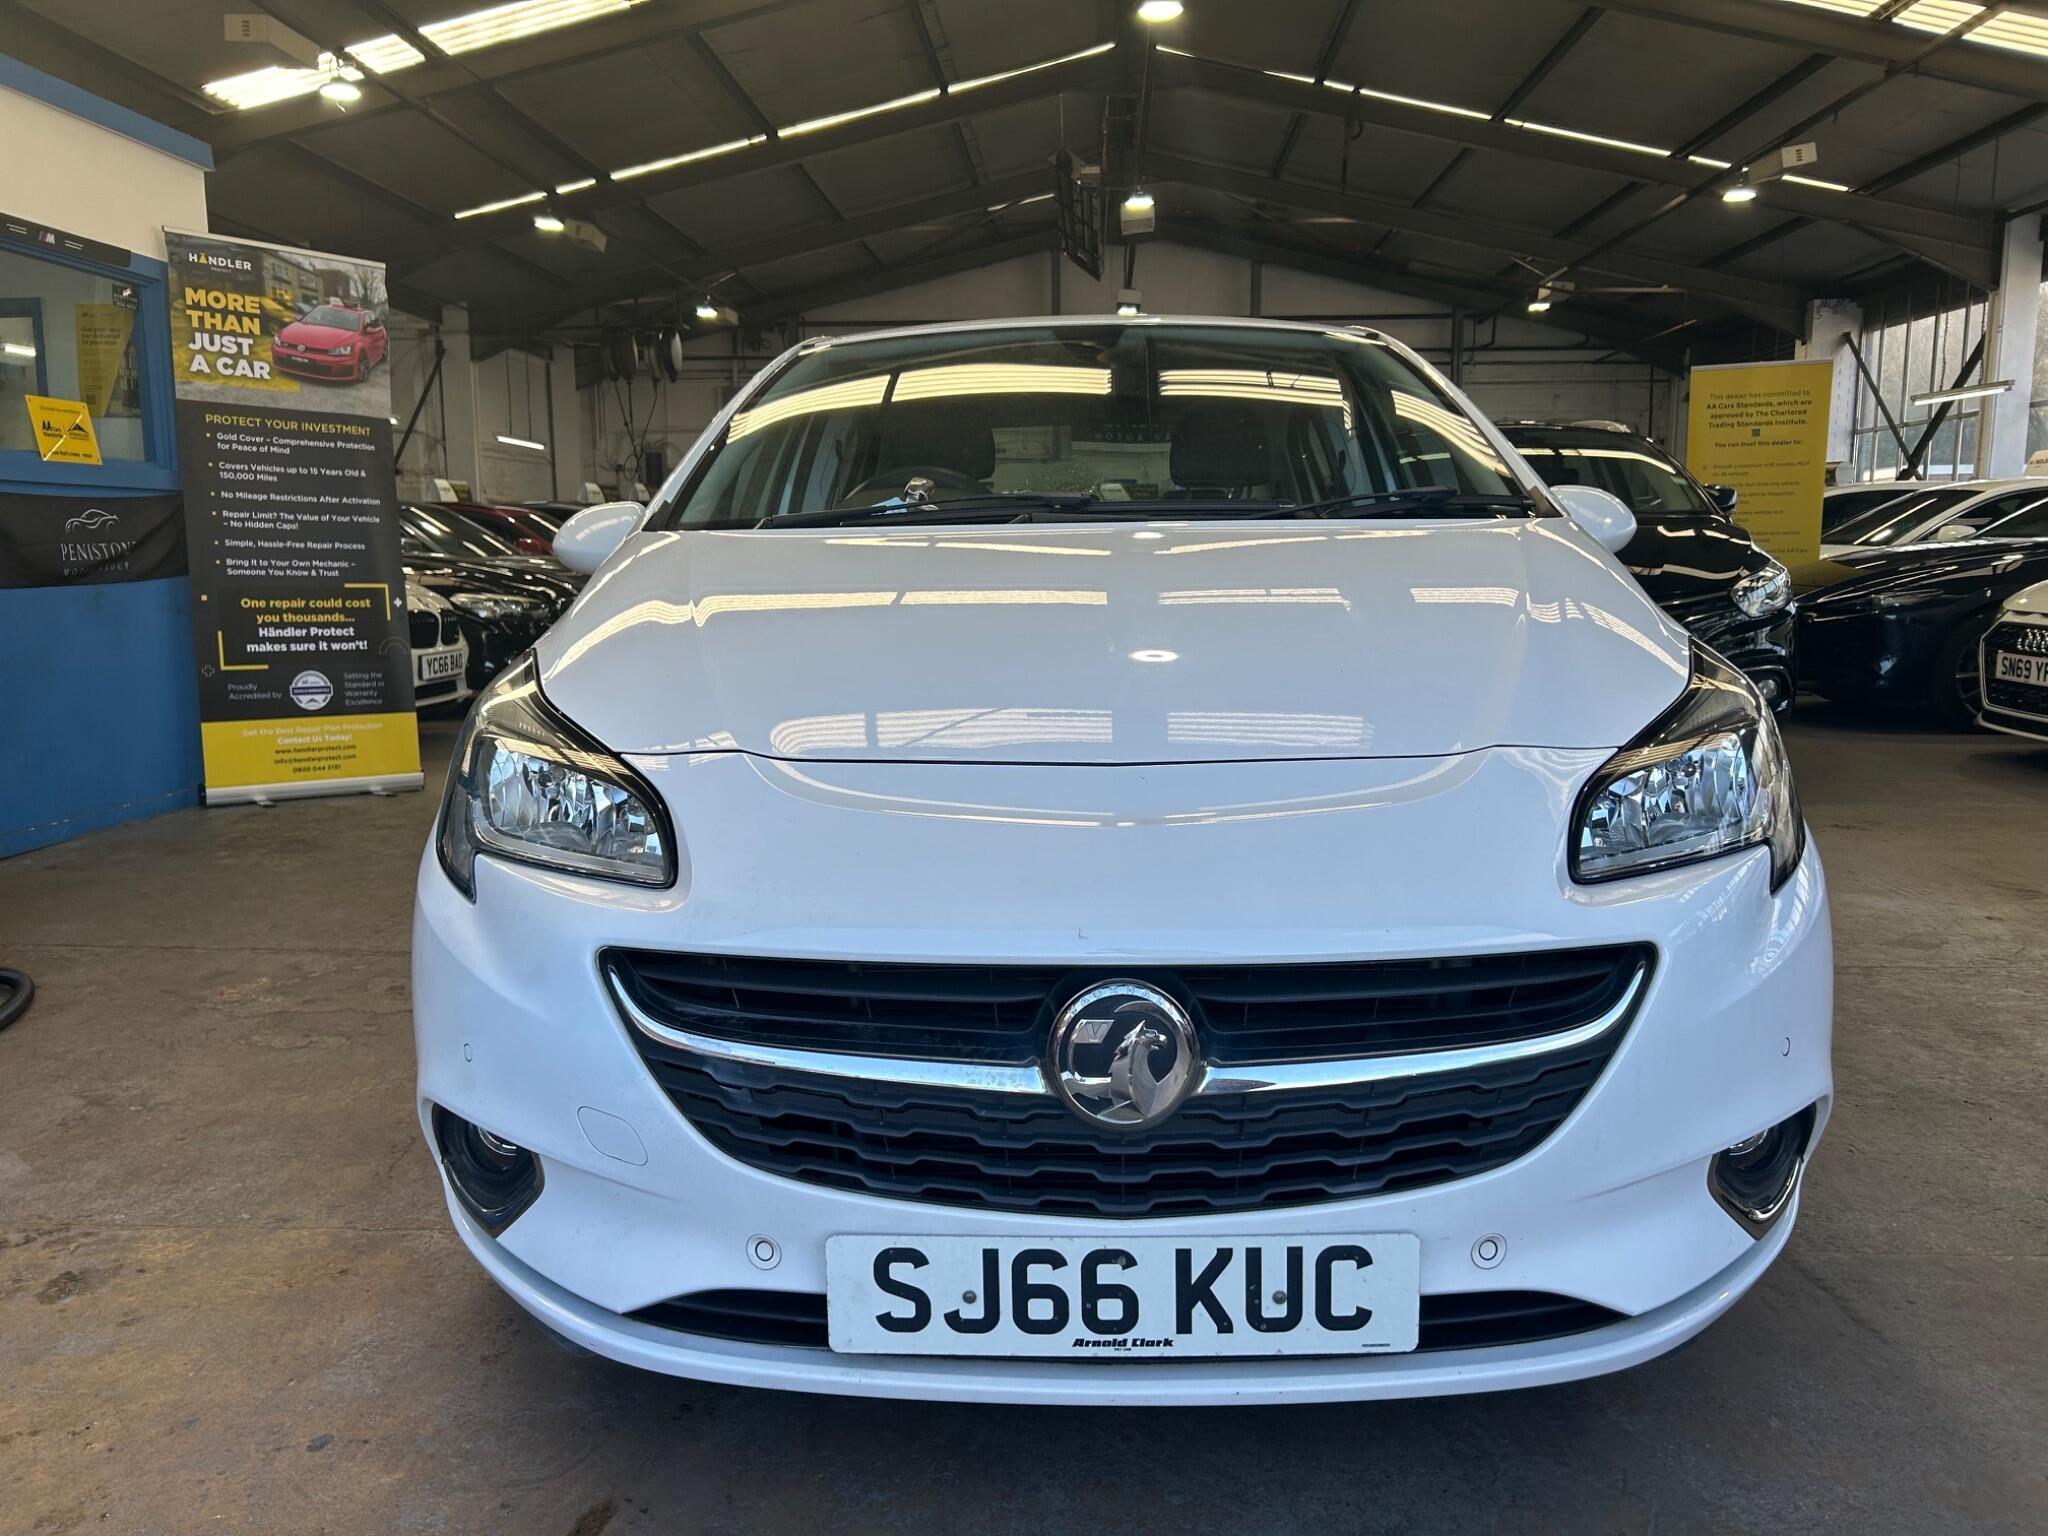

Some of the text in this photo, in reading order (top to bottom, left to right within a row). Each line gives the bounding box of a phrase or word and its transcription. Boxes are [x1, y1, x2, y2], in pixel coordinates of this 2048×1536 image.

[185, 287, 260, 315] MORE
[186, 310, 260, 336] THAN
[188, 332, 253, 355] JUST
[190, 354, 271, 380] A CAR
[206, 414, 371, 436] PROTECT YOUR INVESTMENT
[216, 433, 376, 451] Gold Cover Comprehensive Protection
[217, 442, 230, 450] for
[232, 444, 258, 452] Peace
[270, 446, 290, 454] Mind
[219, 462, 248, 470] Covers
[250, 464, 284, 473] Vehicles
[299, 466, 308, 474] to
[320, 468, 342, 476] Years
[345, 469, 359, 477] Old
[220, 471, 277, 482] 150,000 Miles
[236, 492, 268, 500] Mileage
[270, 494, 317, 503] Restrictions
[342, 497, 381, 505] Activation
[222, 510, 250, 519] Repair
[252, 511, 277, 519] Limit?
[279, 512, 294, 520] The
[296, 513, 319, 521] Value
[352, 515, 380, 523] Vehicle
[276, 522, 299, 530] Caps!
[60, 541, 136, 560] PENISTON
[225, 539, 366, 550] Simple, Hassle-Free Repair Process
[226, 558, 249, 567] Bring
[227, 568, 265, 576] Someone
[240, 598, 371, 610] One repair could cost
[256, 613, 355, 624] you thousands...
[259, 626, 355, 638] Händler Protect
[246, 640, 368, 652] makes sure it won't!
[427, 655, 449, 676] YC66
[2001, 656, 2032, 680] SN69
[278, 736, 310, 744] Contact
[872, 1244, 1374, 1335] SJ66 KUC
[1072, 1338, 1174, 1347] Arnold Clark
